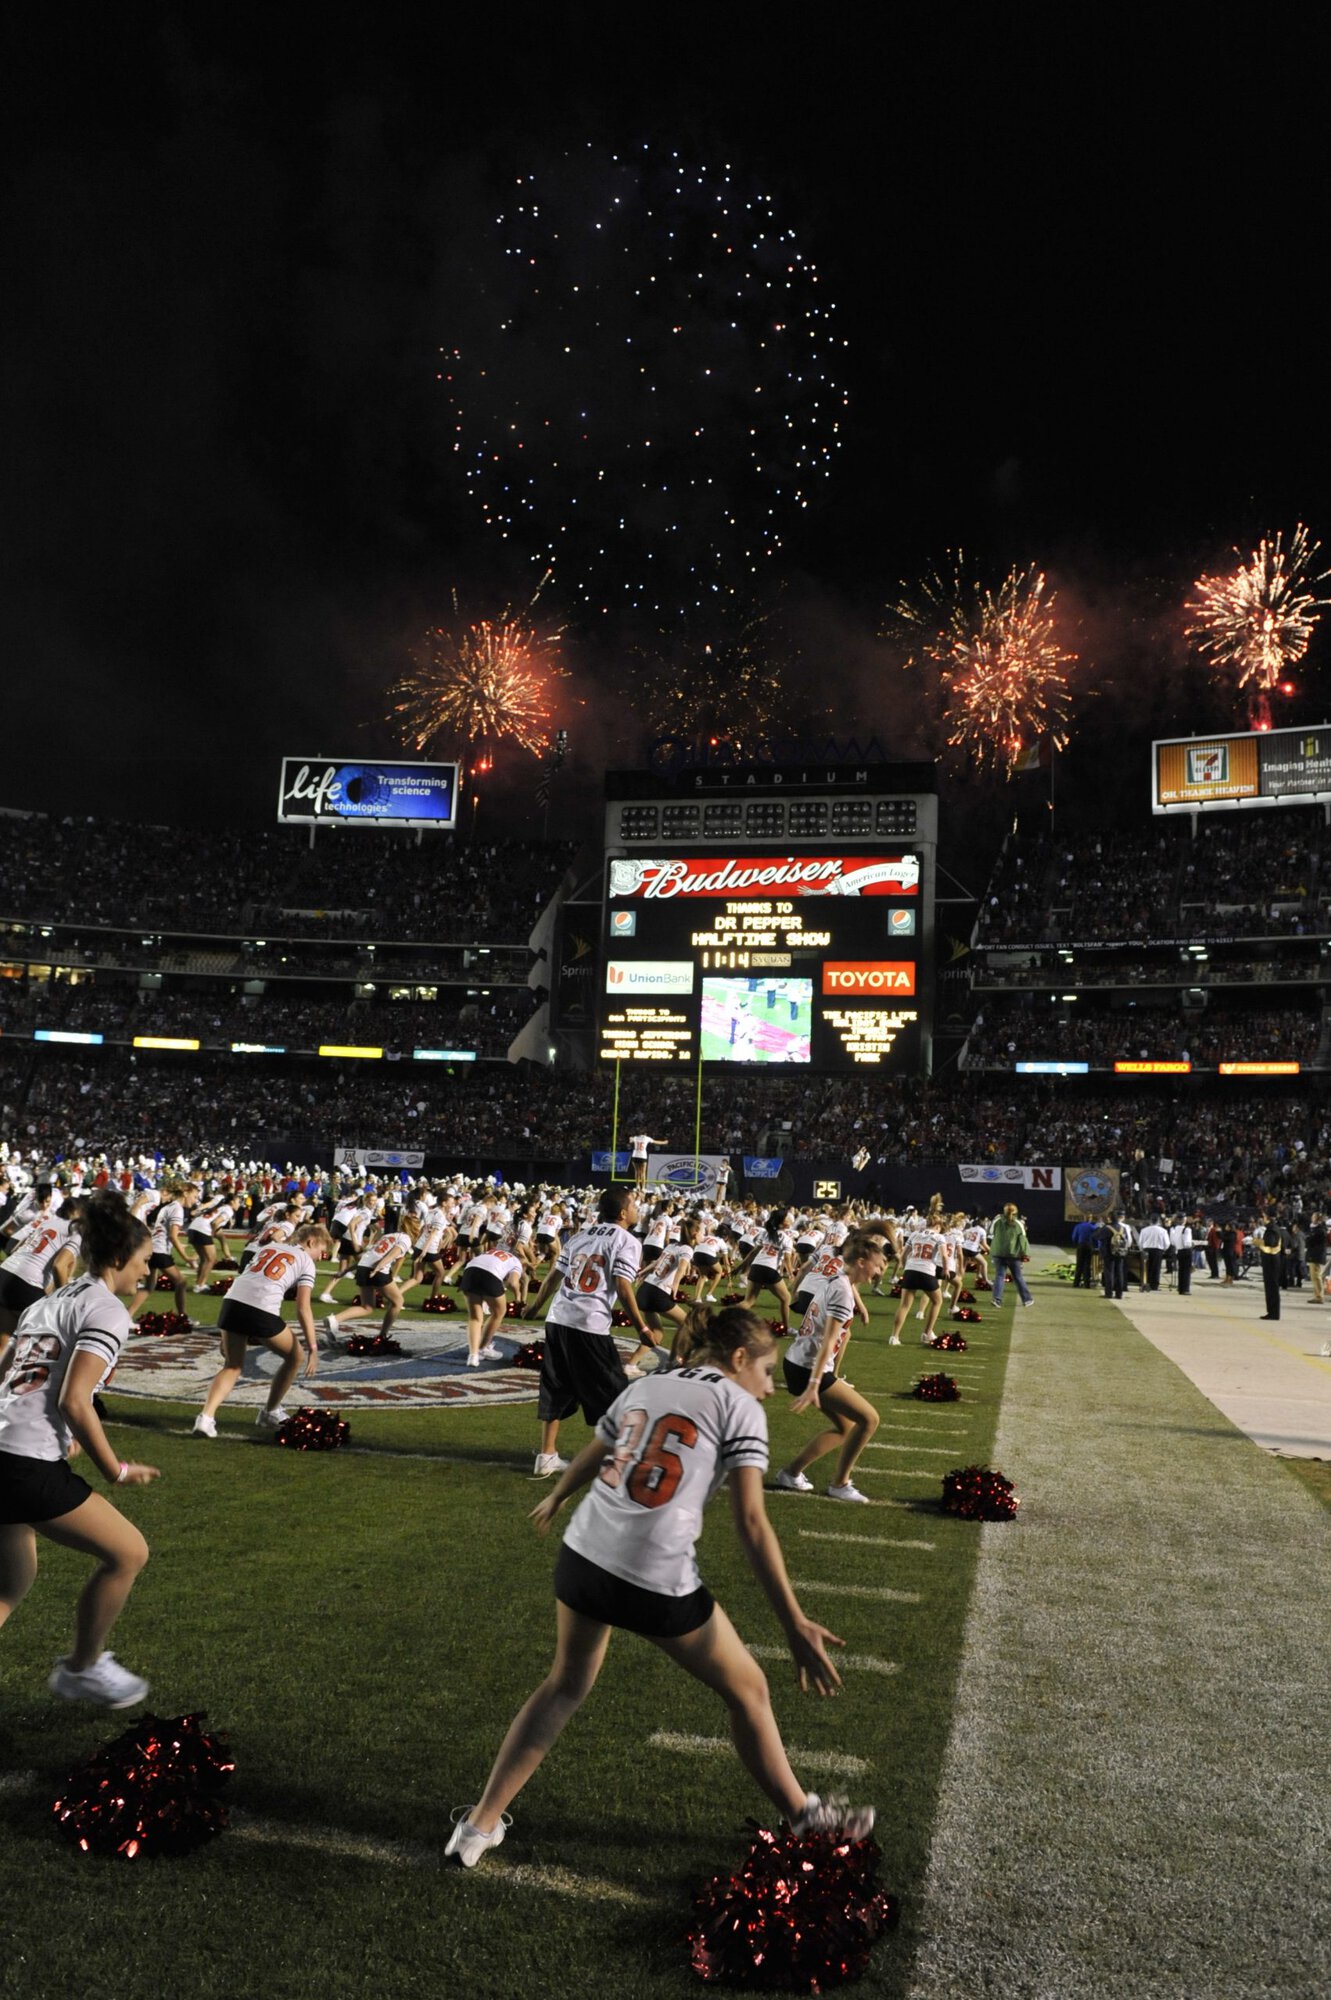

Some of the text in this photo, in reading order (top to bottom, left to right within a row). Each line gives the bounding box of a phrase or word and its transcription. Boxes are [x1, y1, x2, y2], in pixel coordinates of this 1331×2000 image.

[1262, 762, 1304, 773] Imaging
[378, 775, 448, 788] Transforming
[695, 771, 868, 785] STADIUM
[284, 765, 342, 813] life
[392, 786, 431, 796] science
[324, 802, 389, 813] technologies
[637, 857, 843, 898] Budweiser
[844, 871, 887, 889] American
[727, 902, 793, 914] THANKS TO
[715, 916, 802, 930] DR PEPPER
[692, 932, 830, 946] HALFTIME SHOW
[702, 951, 750, 969] 11:14
[561, 964, 593, 979] Sprint
[827, 971, 911, 987] TOYOTA
[844, 1010, 889, 1020] PACIFIC
[890, 1011, 918, 1021] LIFE
[1116, 1062, 1189, 1073] WELLS FARGO
[340, 1150, 359, 1167] A
[666, 1160, 694, 1172] PACIFIC
[1031, 1168, 1054, 1188] N
[816, 1182, 838, 1198] 25
[588, 1226, 617, 1237] BGA
[249, 1247, 295, 1281] 36
[565, 1253, 607, 1293] 36
[599, 1408, 698, 1509] 36
